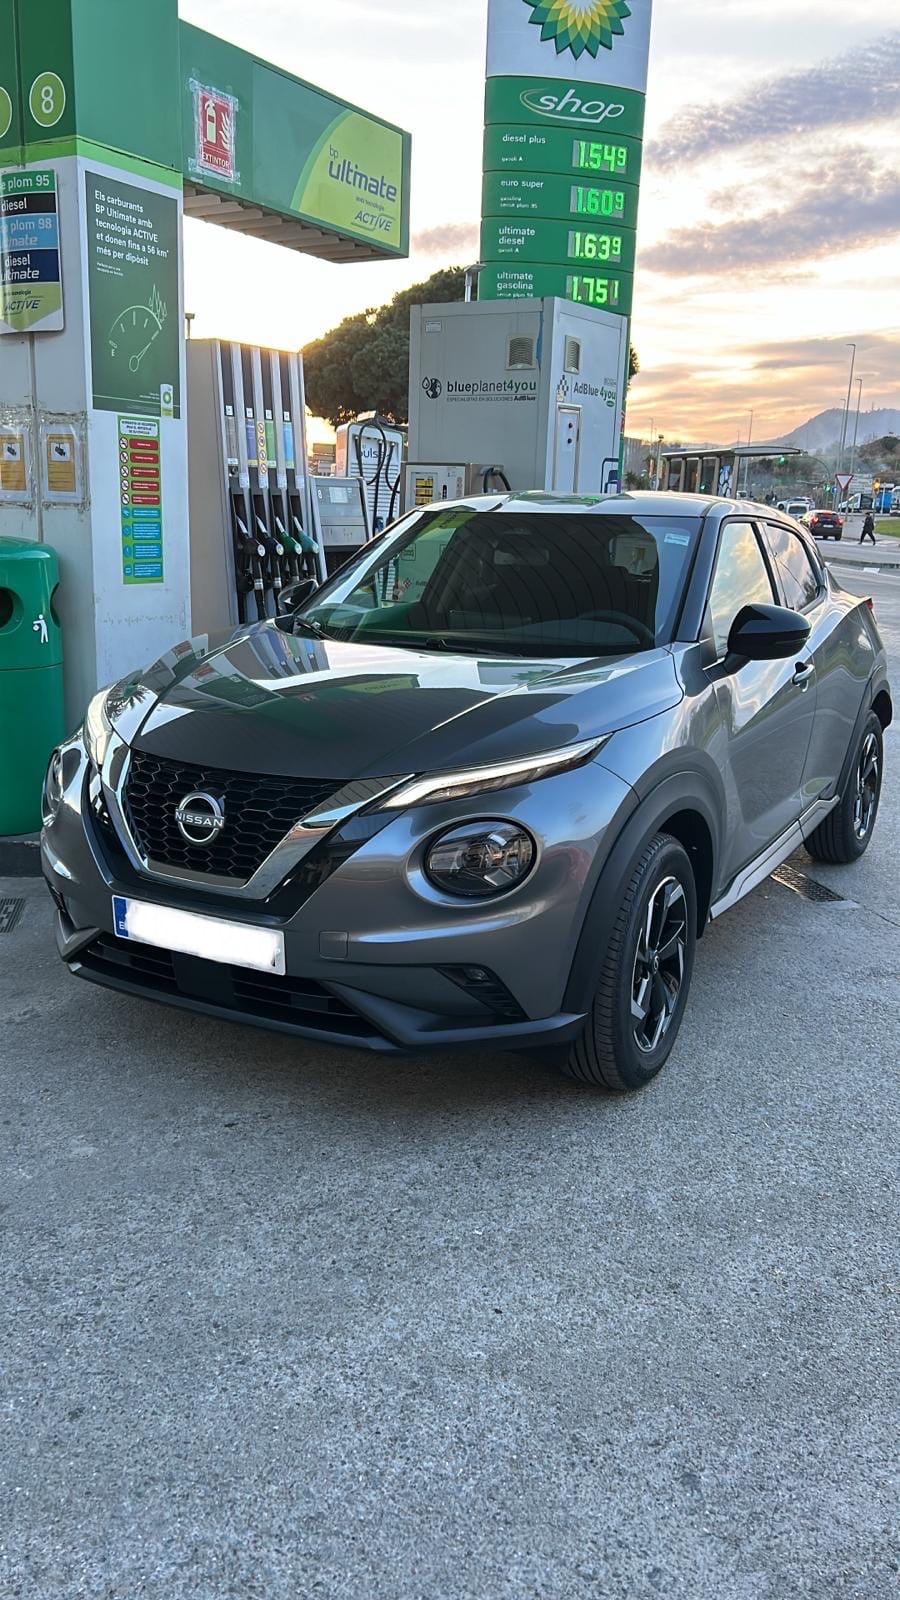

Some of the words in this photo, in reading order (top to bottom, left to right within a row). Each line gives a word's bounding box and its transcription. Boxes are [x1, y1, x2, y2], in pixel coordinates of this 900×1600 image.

[41, 85, 54, 114] 8
[540, 89, 625, 123] shop
[502, 134, 526, 143] diesel
[529, 135, 546, 144] plus
[330, 144, 338, 159] bp
[579, 140, 627, 172] 1.549
[202, 153, 230, 169] EXTINTOR
[8, 176, 33, 191] plom
[36, 174, 50, 187] 95
[328, 159, 397, 203] ultimate
[521, 180, 544, 189] super
[1, 197, 27, 213] diesel
[95, 189, 106, 202] Els
[107, 196, 144, 213] carburants
[577, 187, 624, 216] 1.609
[96, 203, 105, 214] BP
[106, 207, 137, 224] Ultimate
[137, 217, 153, 229] amb
[355, 211, 392, 231] ACTIVE
[11, 218, 35, 235] plom
[38, 217, 52, 230] 98
[95, 218, 132, 236] tecnologia
[133, 228, 159, 243] ACTIVE
[498, 226, 535, 236] ultimate
[96, 232, 104, 241] et
[105, 234, 127, 248] donen
[127, 239, 141, 251] fins
[141, 245, 147, 253] a
[147, 244, 156, 256] 56
[498, 236, 525, 245] diesel
[575, 231, 622, 260] 1.639
[5, 253, 31, 268] diesel
[112, 250, 125, 260] per
[496, 272, 534, 281] ultimate
[496, 281, 534, 291] gasolina
[447, 380, 537, 395] blueplanet4you
[573, 382, 599, 397] AdBlue
[599, 386, 616, 401] 4you
[175, 810, 224, 828] NISSAN
